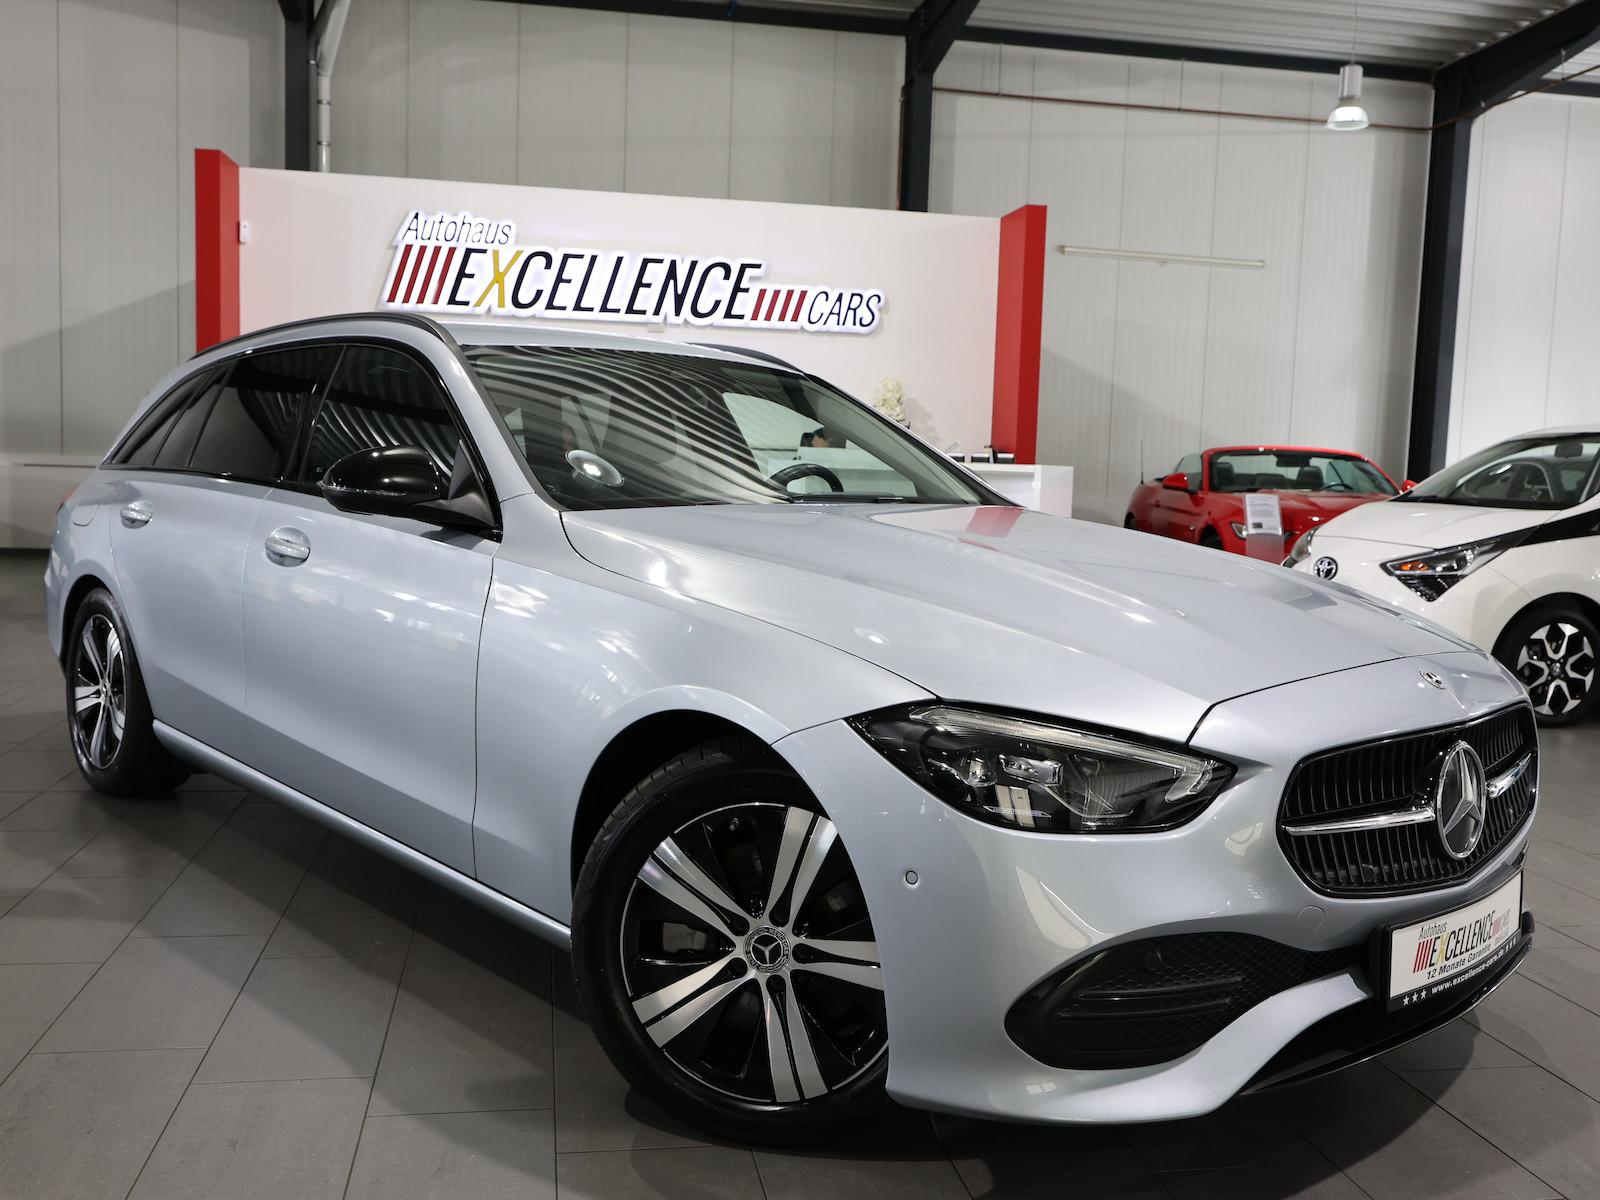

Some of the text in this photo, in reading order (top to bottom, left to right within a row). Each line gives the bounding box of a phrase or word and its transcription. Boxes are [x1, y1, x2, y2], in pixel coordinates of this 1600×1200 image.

[402, 211, 512, 245] Autohaus
[446, 247, 881, 328] EXCELLENCE CARS
[1418, 921, 1447, 940] Autohaus
[1428, 910, 1496, 968] EXCELLENCE
[1427, 968, 1437, 980] 12
[1438, 958, 1466, 976] Monate
